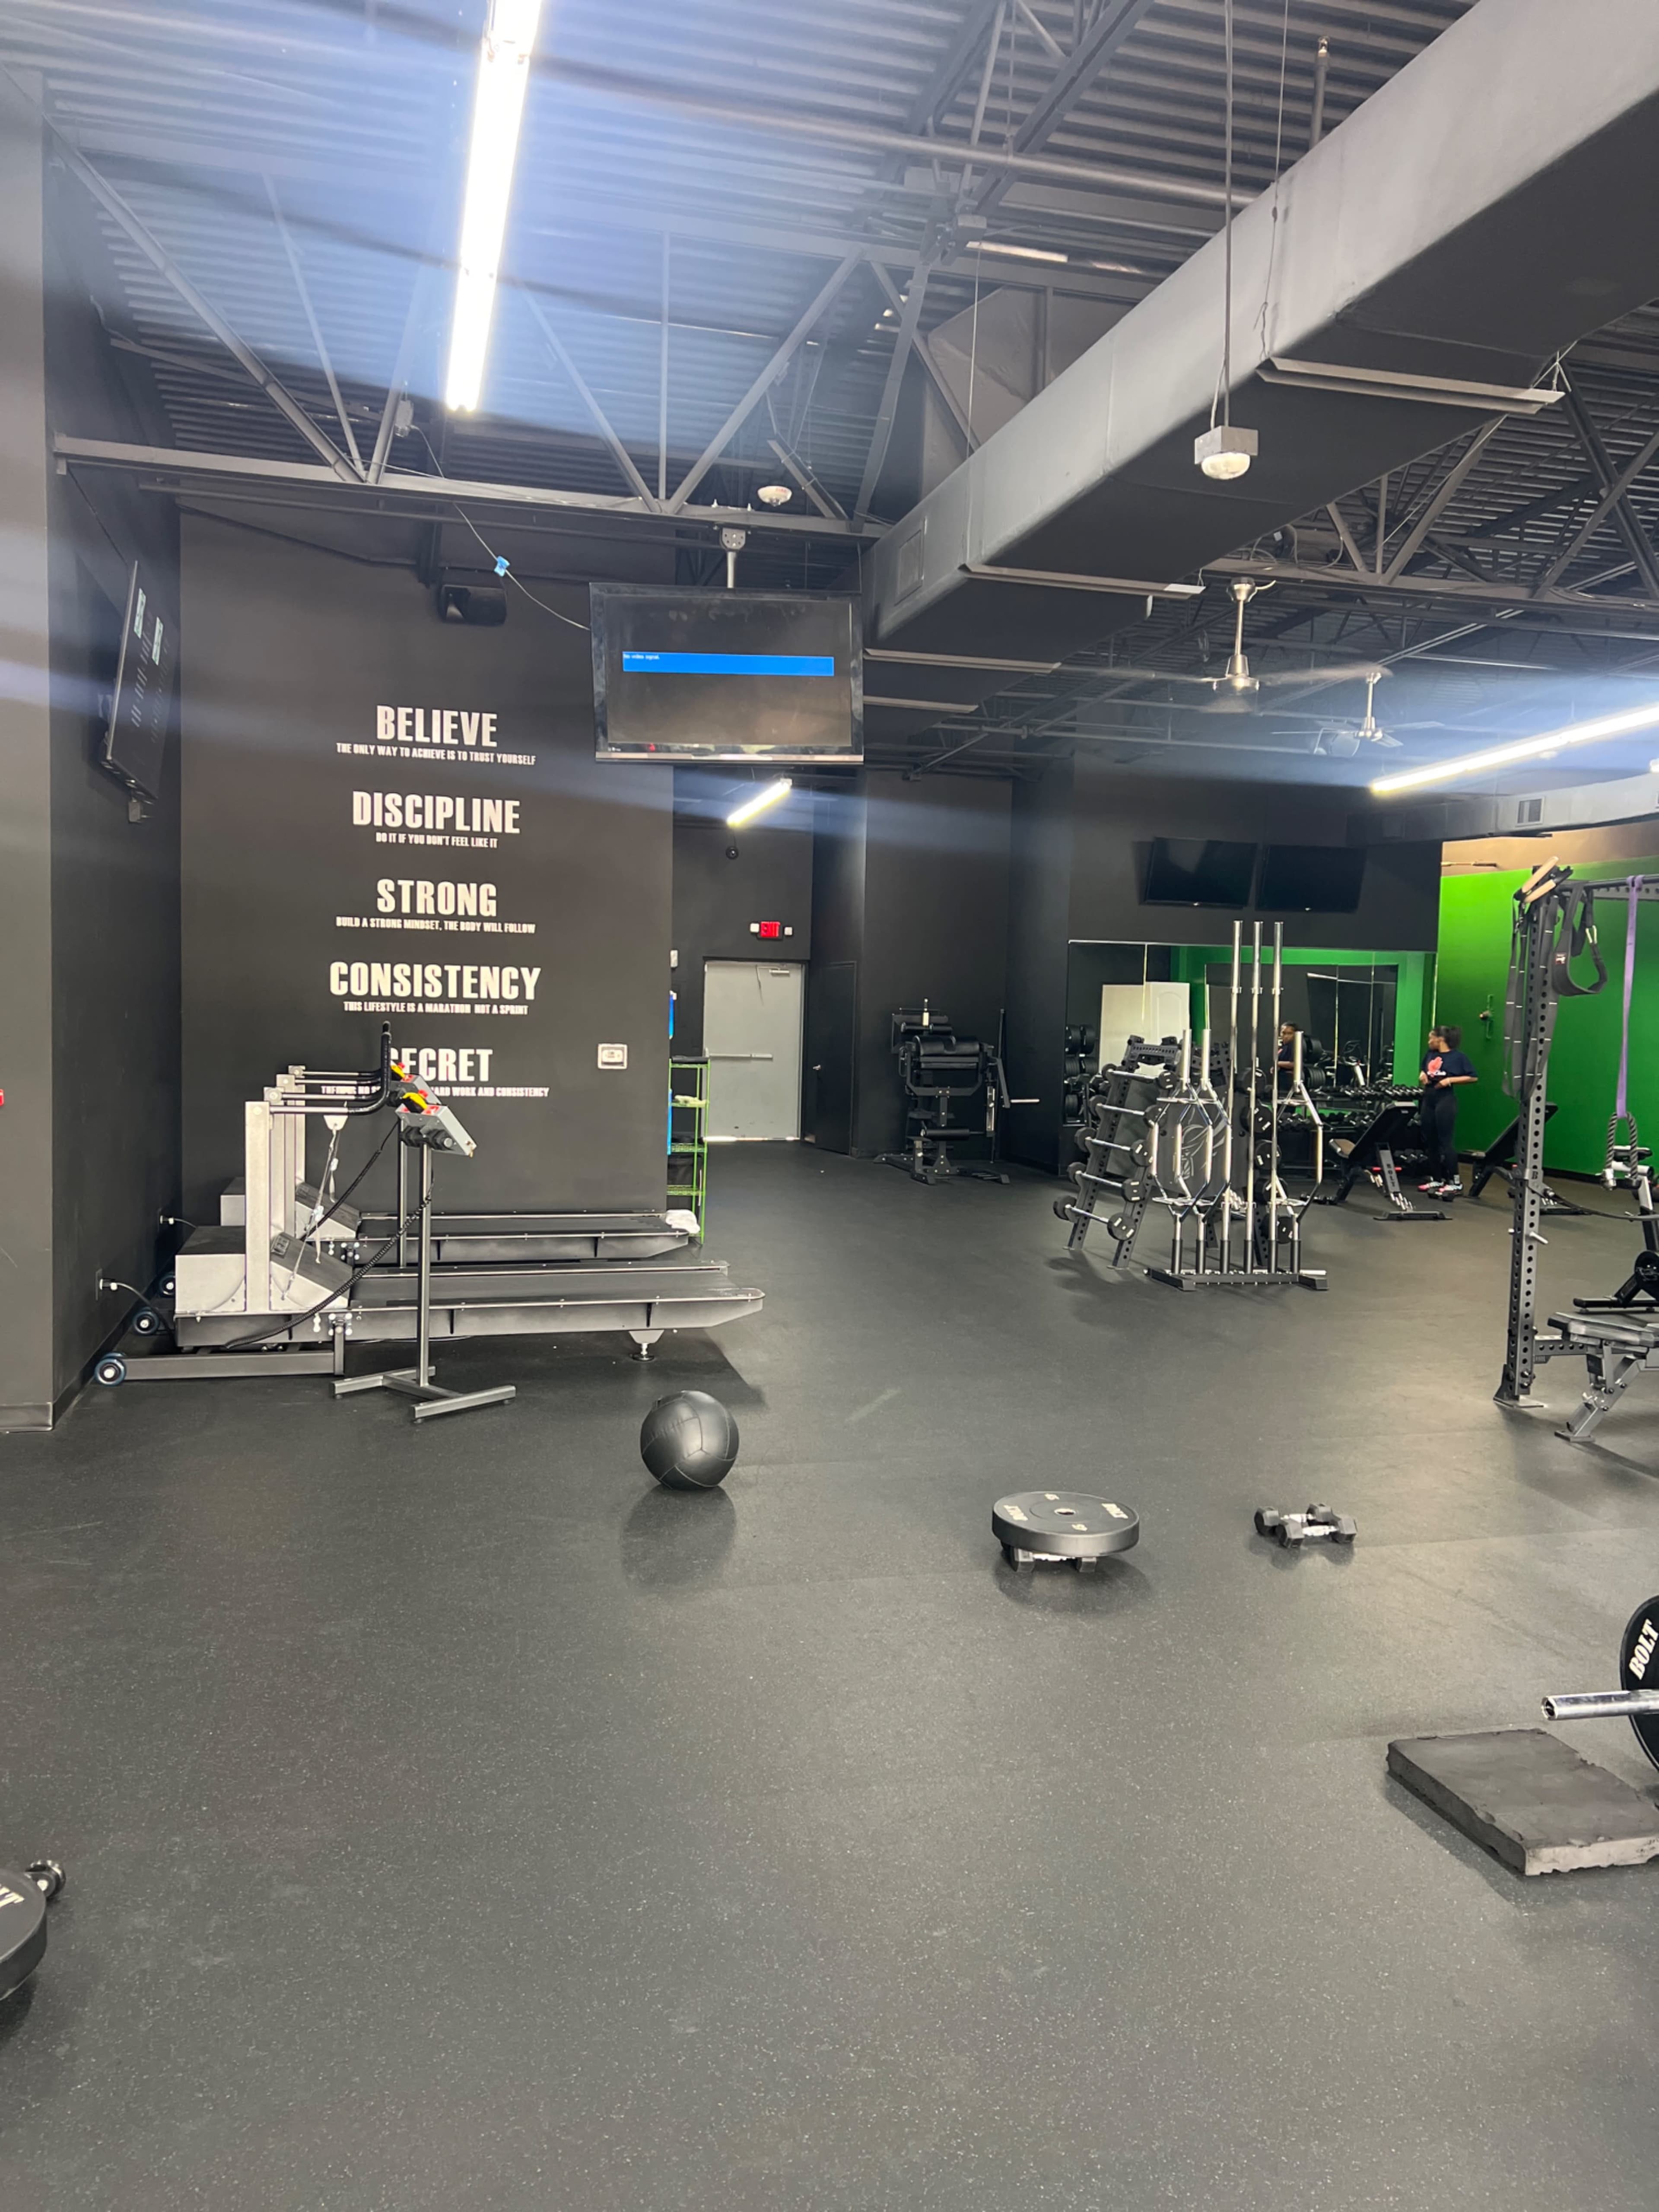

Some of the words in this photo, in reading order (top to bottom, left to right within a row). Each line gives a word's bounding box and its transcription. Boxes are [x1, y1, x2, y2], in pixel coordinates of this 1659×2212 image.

[377, 705, 497, 747] BELIEVE
[336, 742, 351, 753] THE
[353, 744, 375, 755] ONLY
[377, 745, 397, 756] WAY
[399, 747, 410, 757] TO
[411, 747, 445, 760] ACHIEVE
[447, 750, 455, 760] IS
[457, 750, 467, 760] TO
[469, 751, 494, 762] TRUST
[496, 753, 536, 765] YOURSELF
[353, 791, 520, 833] DISCIPLINE
[376, 832, 387, 842] DO
[388, 833, 396, 842] IT
[398, 833, 406, 843] IF
[408, 833, 424, 844] YOU
[426, 835, 449, 845] DON'T
[451, 836, 469, 846] FEEL
[471, 837, 488, 847] LIKE
[489, 838, 498, 848] IT
[377, 879, 496, 916] STRONG
[336, 916, 360, 927] BUILD
[362, 918, 368, 927] A
[369, 918, 402, 928] STRONG
[444, 920, 458, 930] THE
[460, 921, 481, 931] BODY
[483, 922, 502, 932] WILL
[504, 923, 535, 933] FOLLOW
[330, 962, 541, 1000] CONSISTENCY
[343, 1001, 362, 1012] THIS
[364, 1001, 405, 1012] LIFESTYLE
[407, 1003, 415, 1012] IS
[417, 1003, 423, 1012] A
[425, 1003, 470, 1013] MARATHON
[474, 1004, 490, 1014] NOT
[492, 1004, 498, 1014] A
[499, 1004, 528, 1014] SPRINT
[431, 1087, 450, 1096] ARD
[451, 1087, 477, 1096] WORK
[477, 1087, 495, 1096] AND
[496, 1087, 550, 1096] CONSISTENCY
[1629, 1618, 1659, 1680] BOLT
